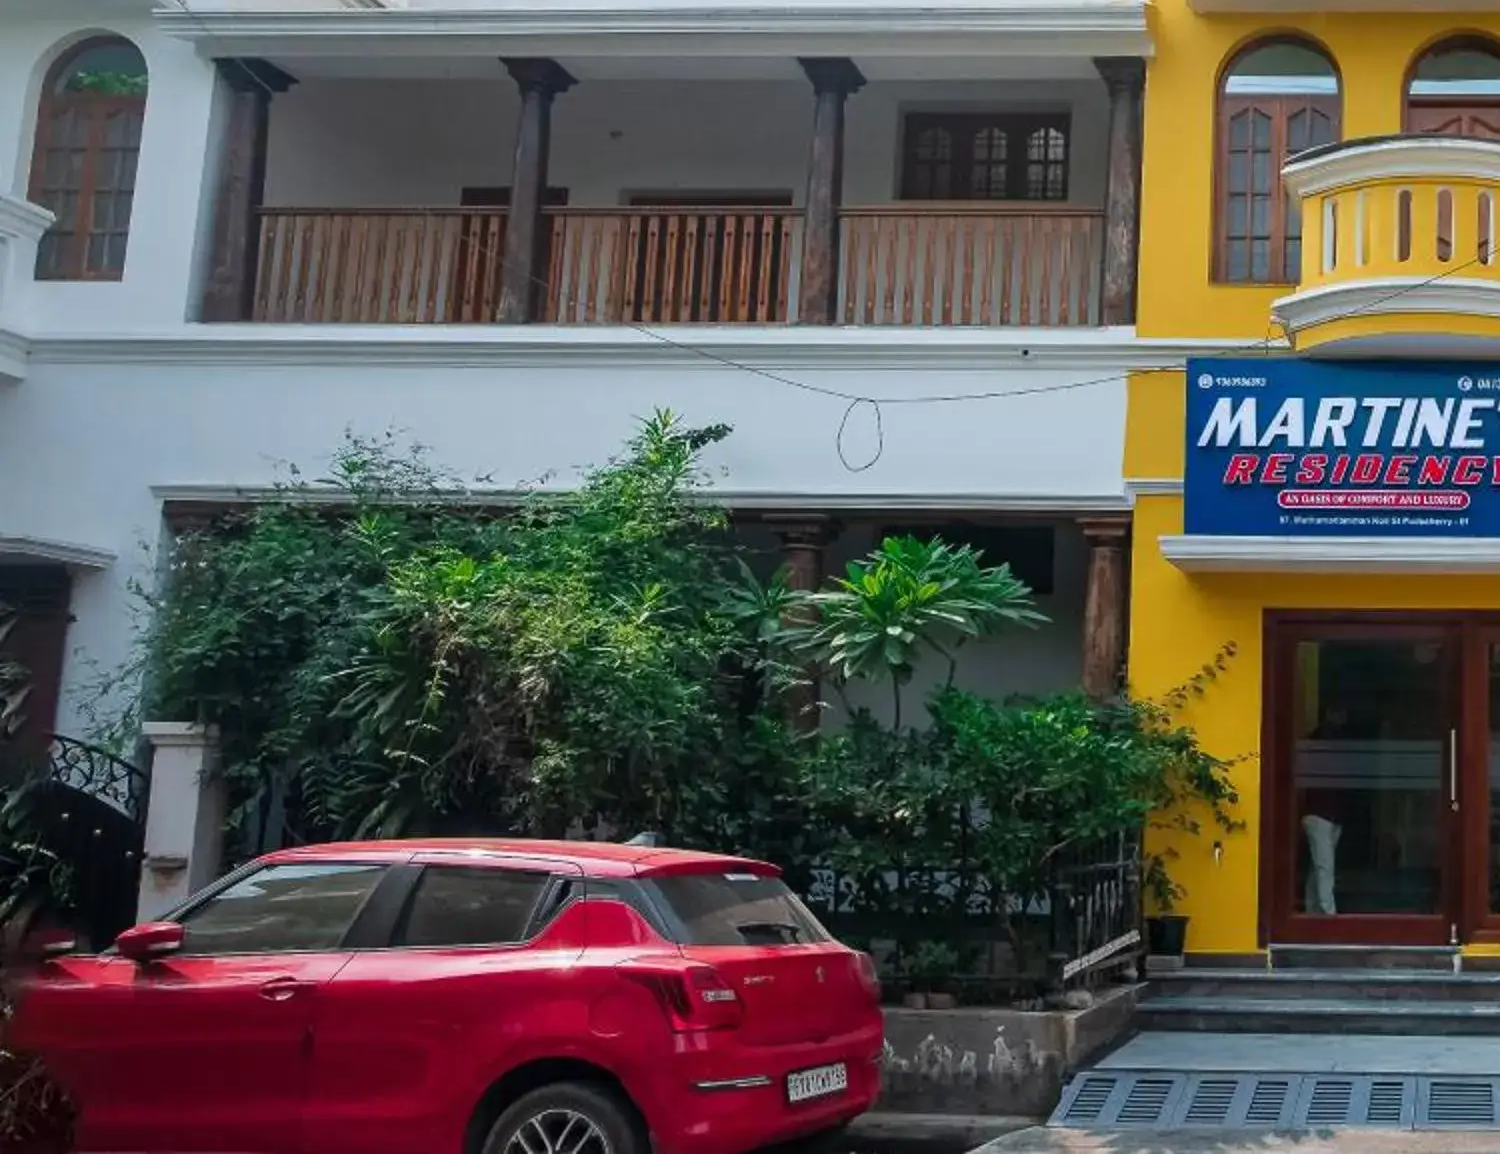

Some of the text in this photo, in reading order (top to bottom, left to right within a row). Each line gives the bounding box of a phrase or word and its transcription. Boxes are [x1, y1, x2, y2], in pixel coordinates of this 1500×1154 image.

[1285, 494, 1463, 505] AN OASIS OF COMFORT AND LUXURY
